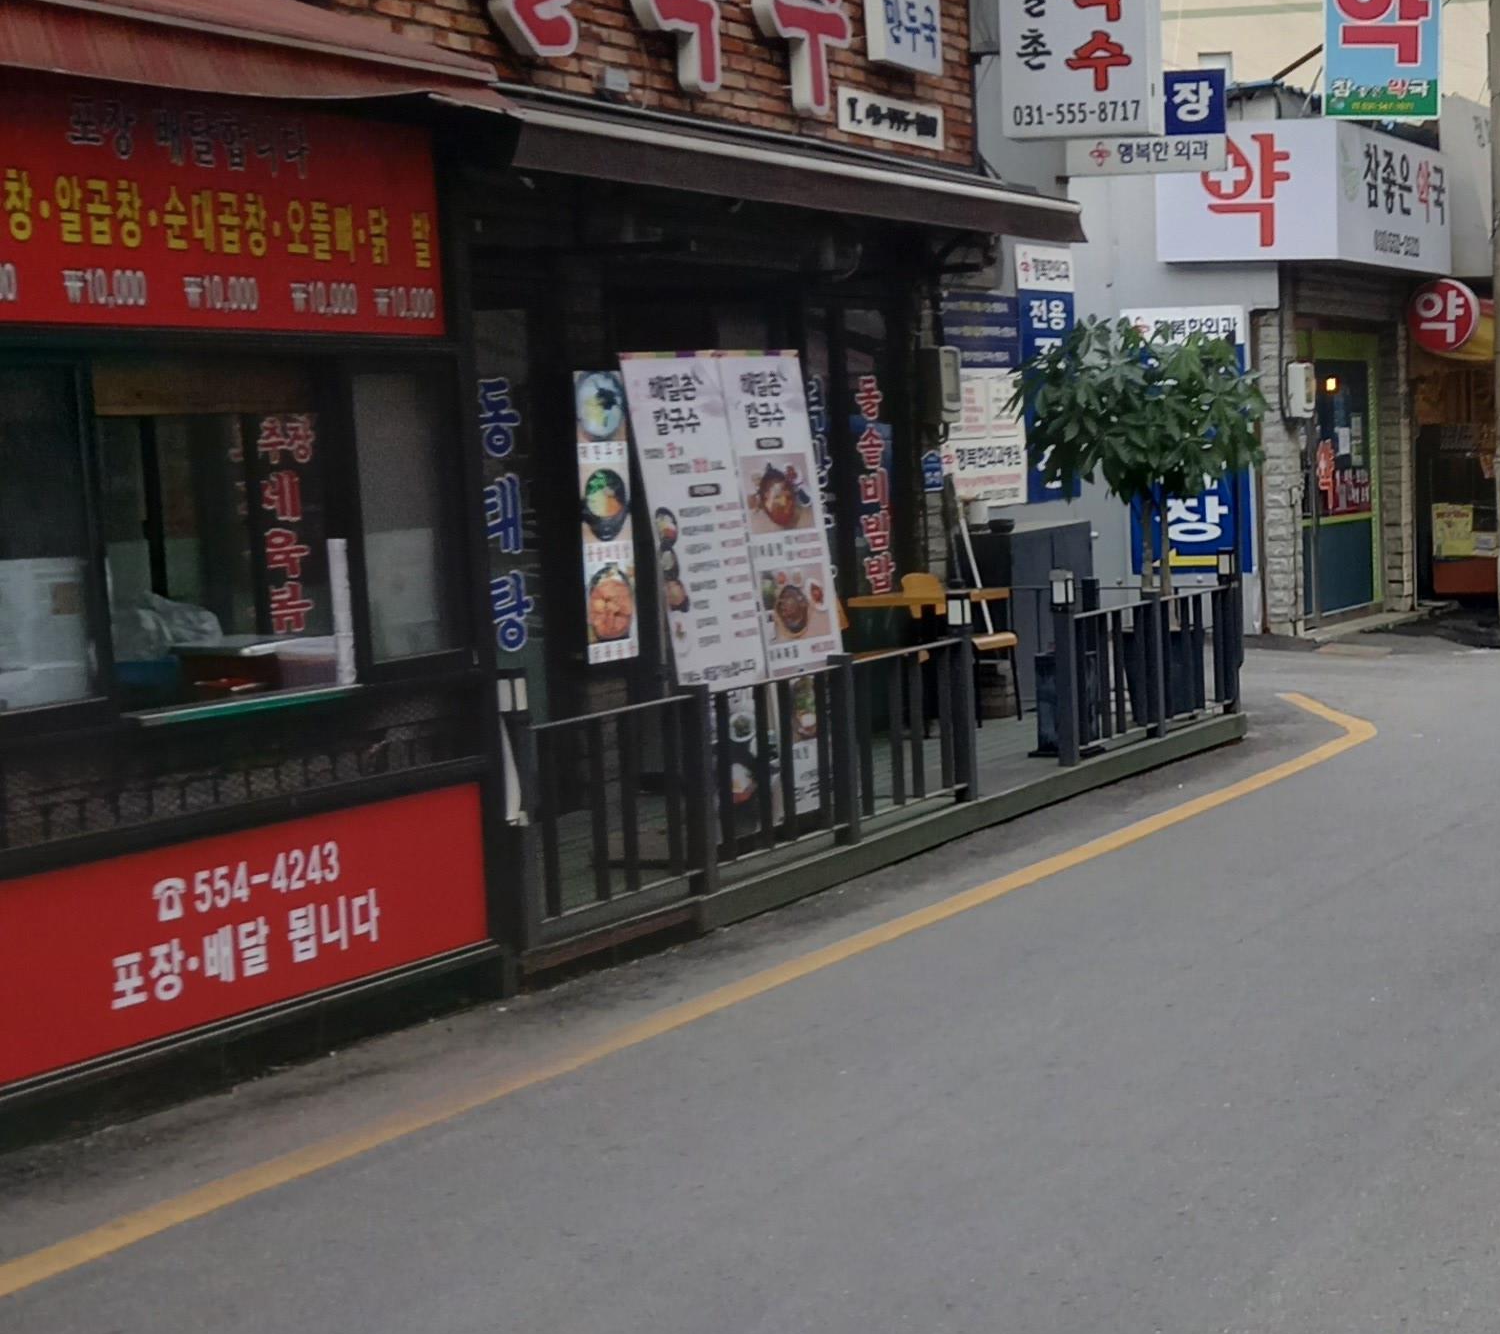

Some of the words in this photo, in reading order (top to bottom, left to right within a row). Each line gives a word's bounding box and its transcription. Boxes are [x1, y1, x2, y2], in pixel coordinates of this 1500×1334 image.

[1013, 100, 1141, 127] 031-555-8717
[1172, 81, 1214, 124] 장
[1174, 139, 1210, 163] 외과
[1202, 133, 1291, 247] 약
[1028, 299, 1068, 331] 전용
[1416, 290, 1466, 344] 약
[477, 377, 534, 652] 동태탕
[193, 840, 340, 914] 554-4243
[287, 887, 380, 964] 됩니다
